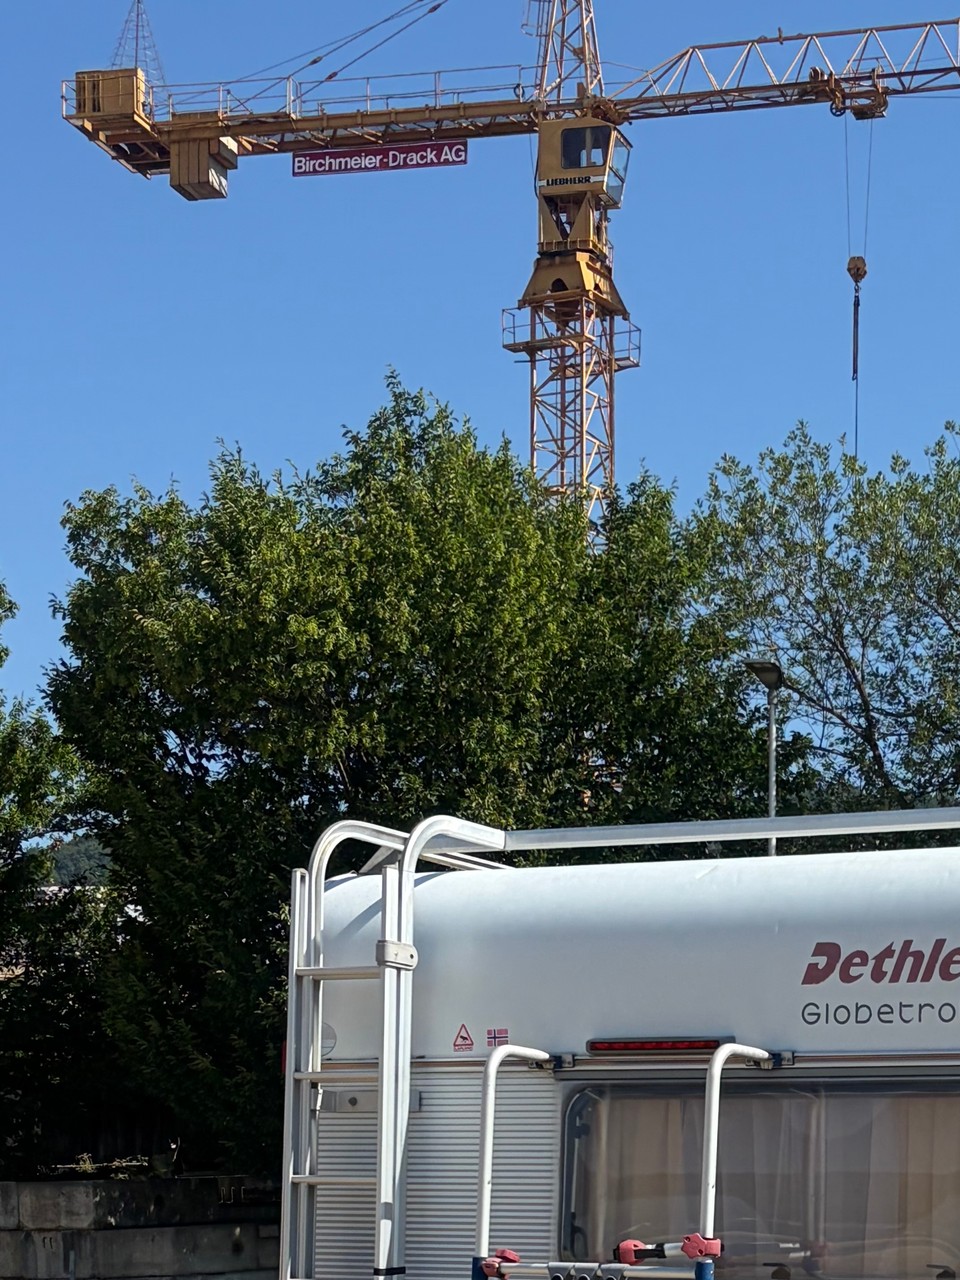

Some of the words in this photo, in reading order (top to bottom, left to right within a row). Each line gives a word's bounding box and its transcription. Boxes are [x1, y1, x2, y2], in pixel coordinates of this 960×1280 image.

[294, 146, 437, 173] Birchmeier-Drack
[440, 144, 466, 163] AG
[546, 176, 591, 187] LIEBHERR
